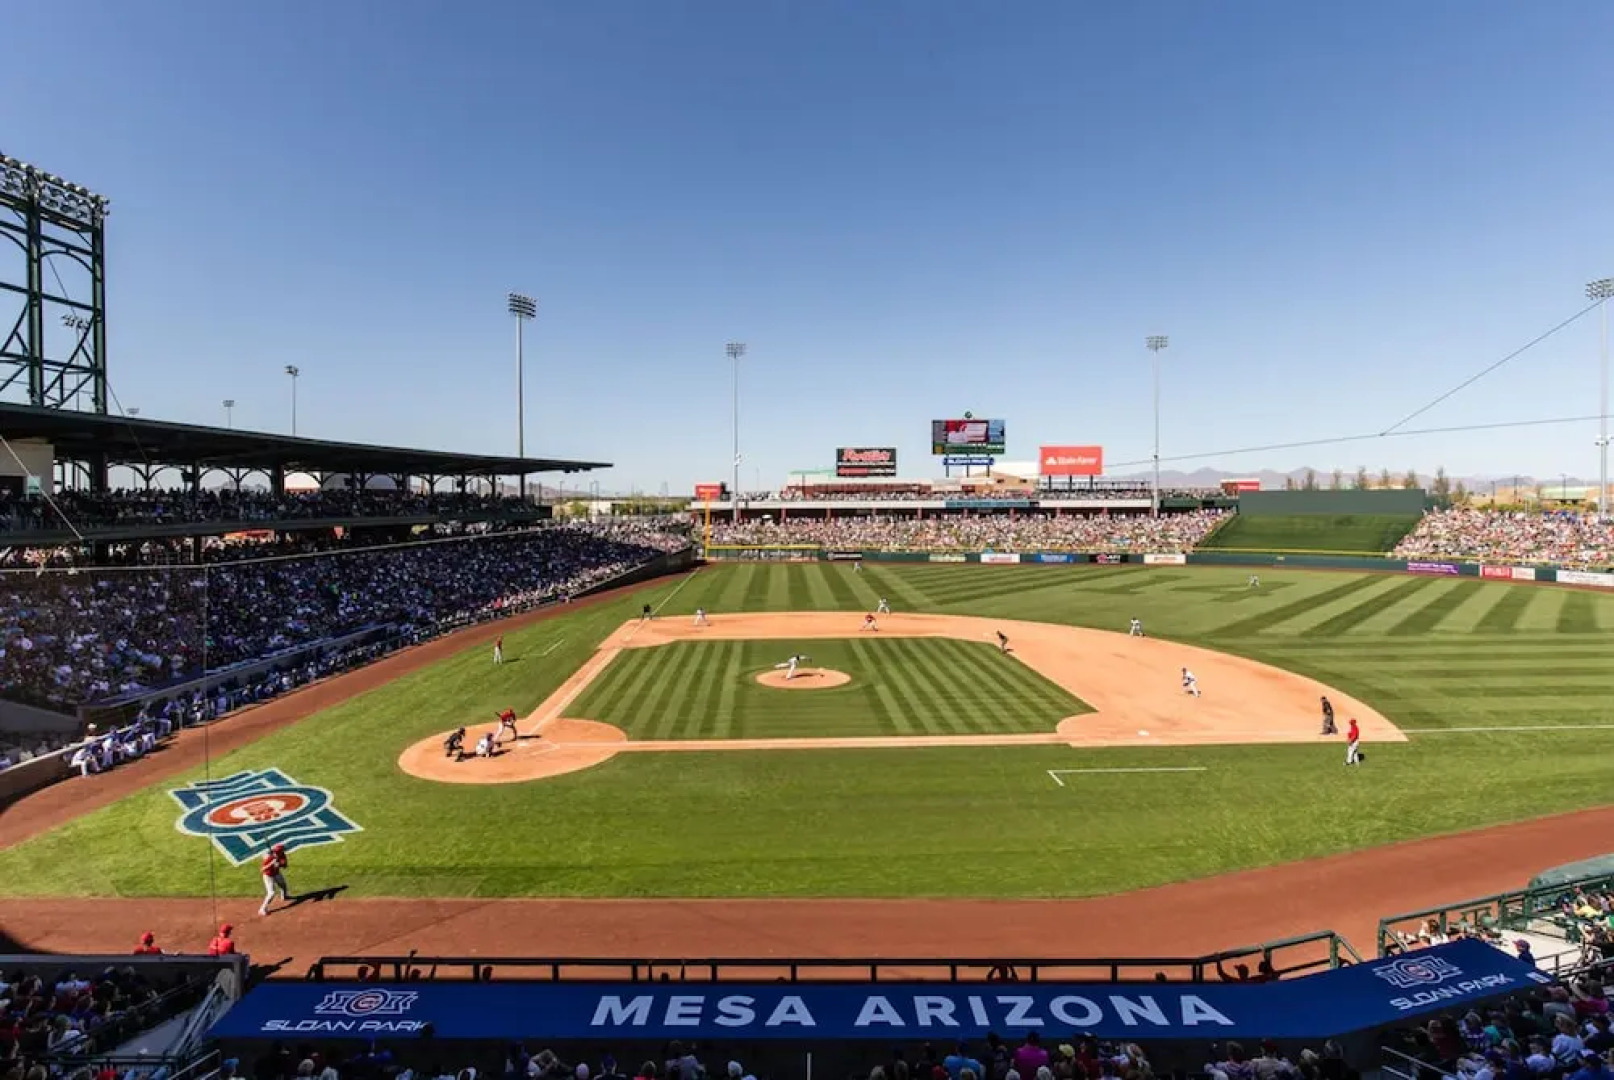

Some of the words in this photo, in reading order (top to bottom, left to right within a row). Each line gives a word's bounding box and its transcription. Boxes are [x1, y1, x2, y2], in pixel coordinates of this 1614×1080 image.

[1390, 986, 1463, 1010] SLOAN
[1459, 973, 1515, 993] PARK
[261, 1020, 355, 1031] SLOAN
[591, 995, 816, 1026] MESA
[854, 995, 1234, 1026] ARIZONA
